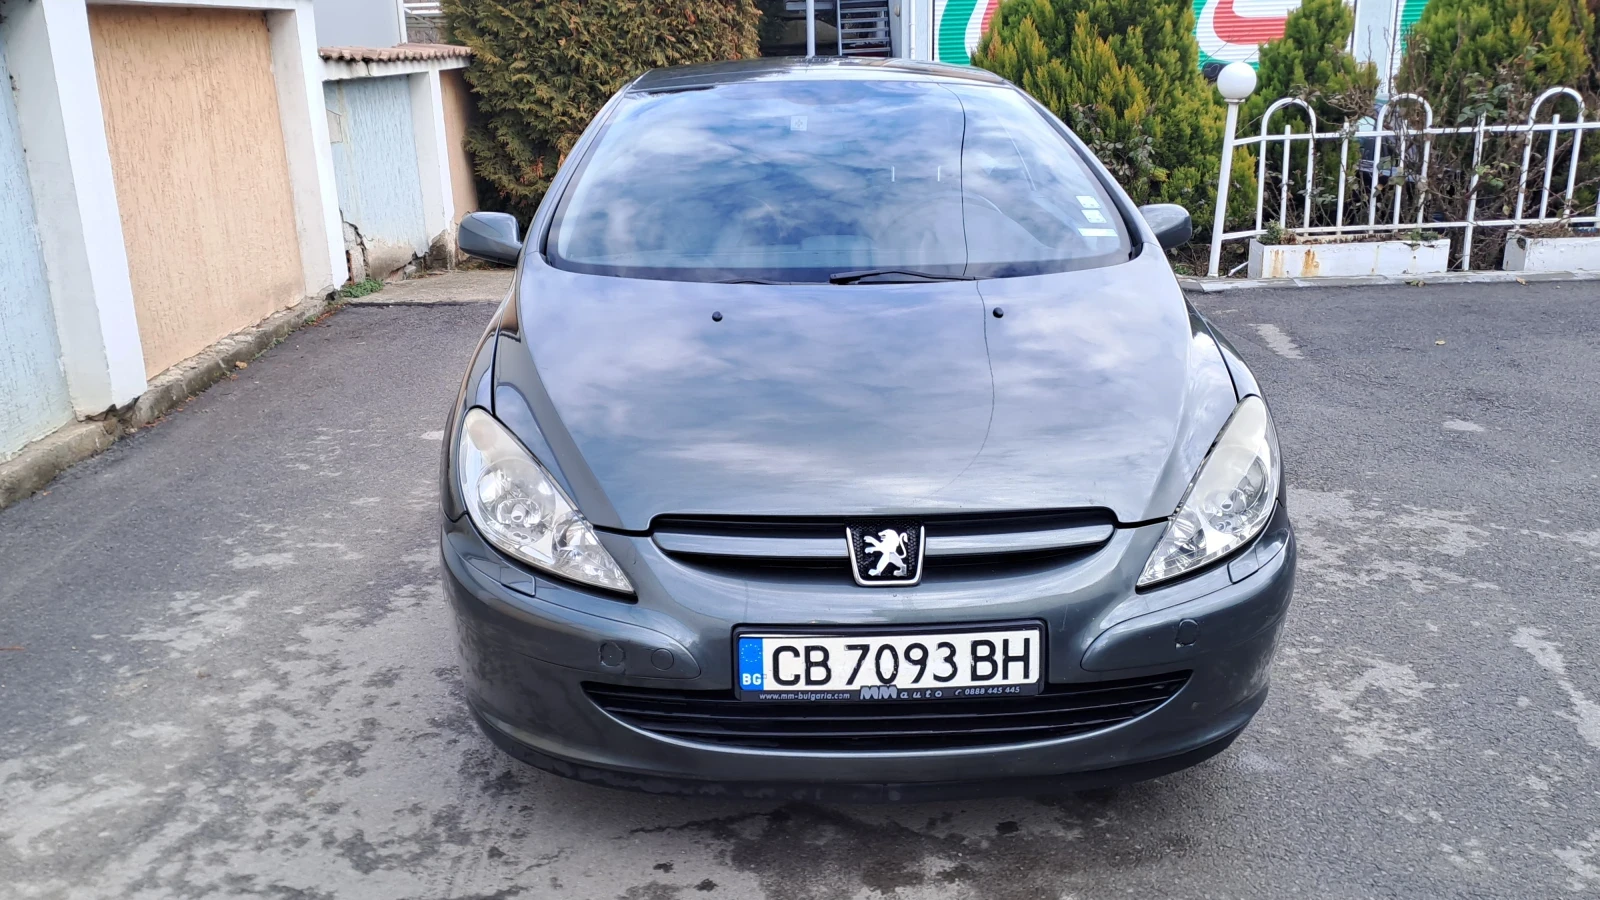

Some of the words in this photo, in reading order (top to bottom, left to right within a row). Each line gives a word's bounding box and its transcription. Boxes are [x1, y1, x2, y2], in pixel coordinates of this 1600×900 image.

[772, 645, 832, 686] CB
[844, 641, 958, 685] 7093
[970, 637, 1031, 682] BH
[742, 673, 762, 686] BG
[759, 692, 851, 701] www.mm-bulgaria.com
[860, 684, 897, 700] MM
[900, 689, 943, 699] auto
[964, 687, 985, 695] 0888
[987, 686, 1003, 694] 445
